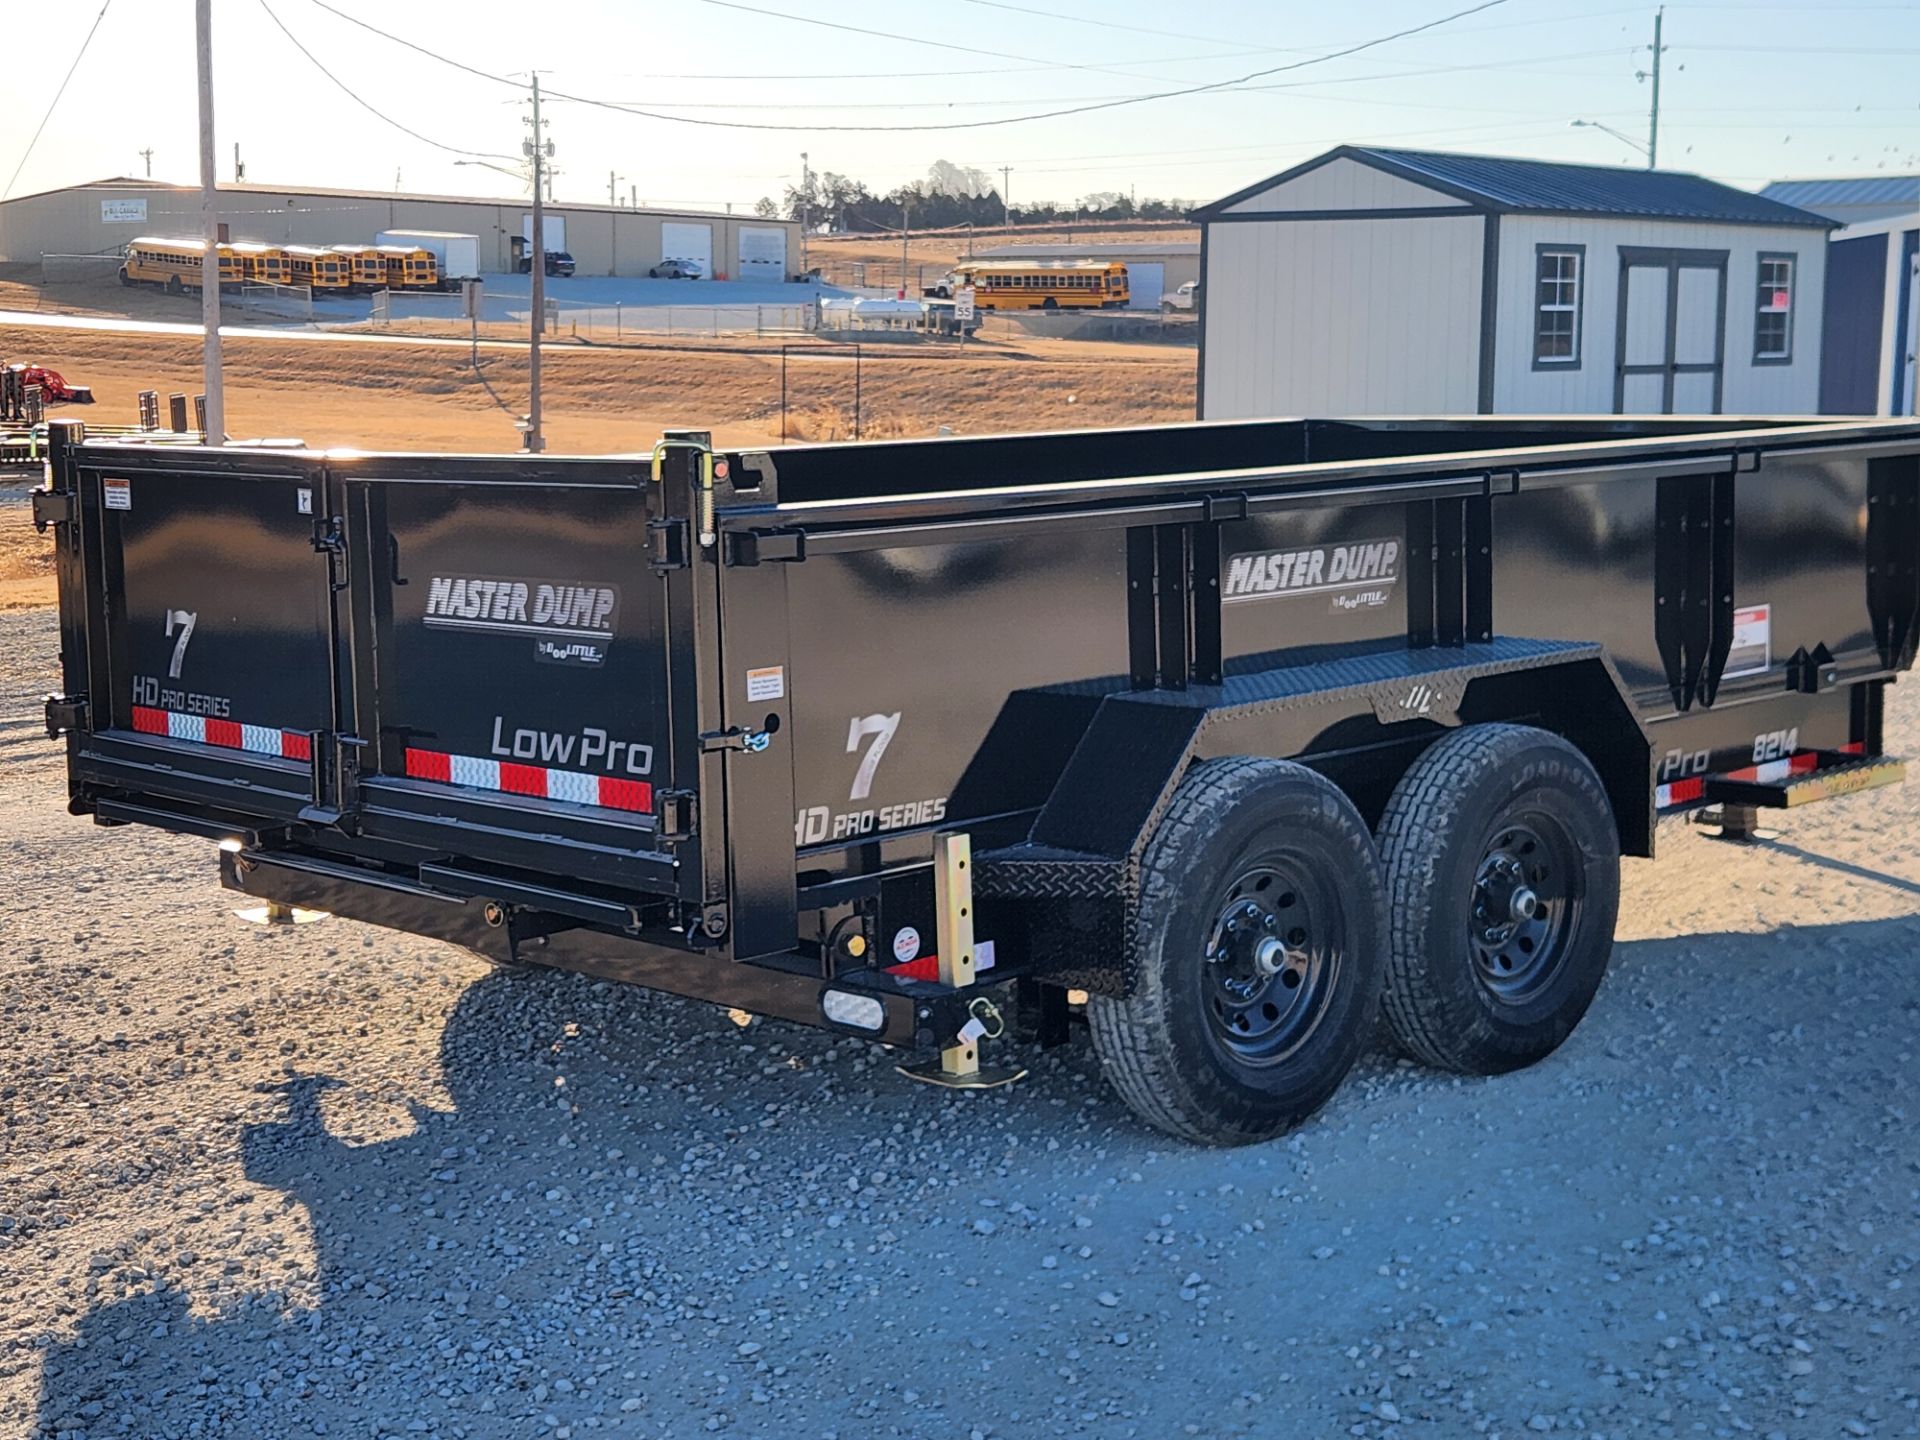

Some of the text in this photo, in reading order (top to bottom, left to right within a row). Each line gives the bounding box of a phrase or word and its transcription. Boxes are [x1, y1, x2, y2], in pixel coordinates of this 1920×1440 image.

[957, 307, 971, 317] 55
[1223, 549, 1324, 595] MASTER
[426, 577, 528, 622] MASTER
[165, 608, 198, 679] 7
[132, 675, 231, 718] HD PRO SERIES
[846, 711, 902, 801] 7
[1657, 748, 1711, 780] Pro
[1752, 727, 1799, 762] 8214
[833, 809, 874, 839] PRO
[878, 797, 948, 831] SERIES
